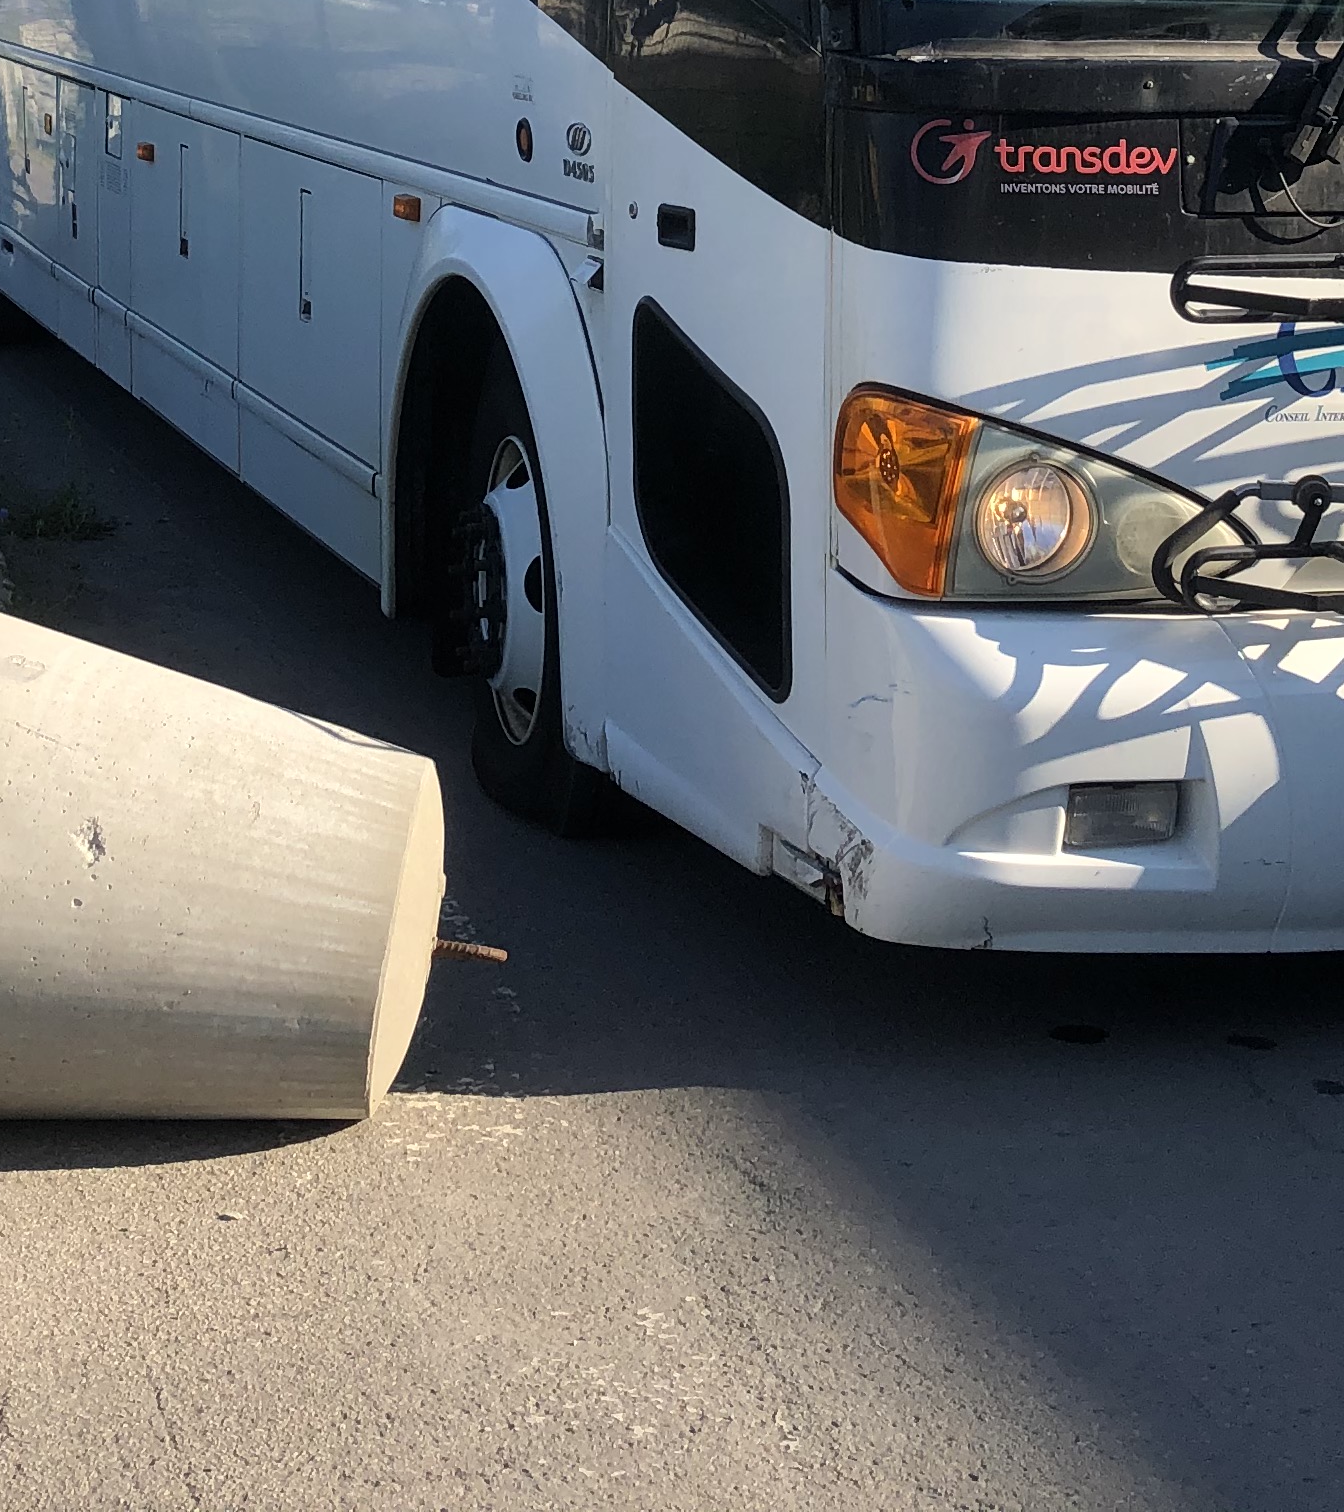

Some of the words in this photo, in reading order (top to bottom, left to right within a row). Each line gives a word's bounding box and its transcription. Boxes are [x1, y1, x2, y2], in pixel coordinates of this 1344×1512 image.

[994, 139, 1177, 175] transdev
[1000, 183, 1066, 194] INVENTONS
[1068, 184, 1105, 195] VOTRE
[1107, 182, 1159, 195] MOBILITÉ
